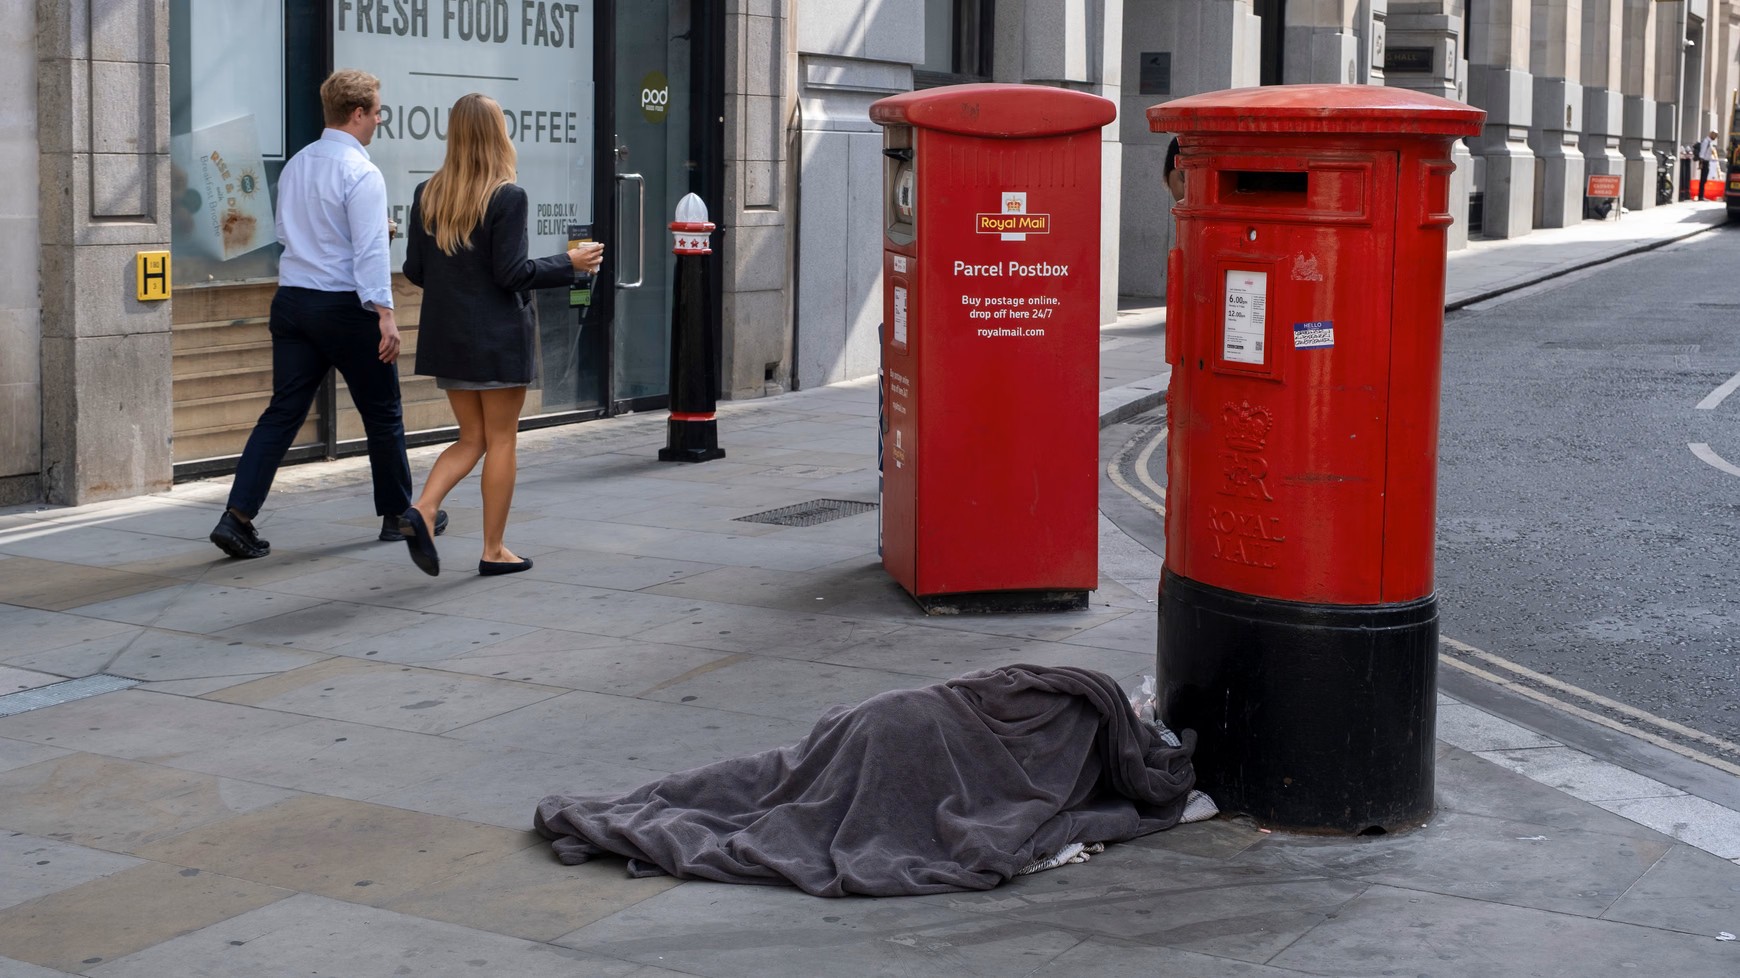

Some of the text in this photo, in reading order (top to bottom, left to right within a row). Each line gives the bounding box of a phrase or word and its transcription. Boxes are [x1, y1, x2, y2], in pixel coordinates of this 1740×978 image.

[338, 0, 579, 49] FRESH FOOD FAST
[641, 86, 668, 108] pod
[377, 104, 577, 143] RIOU OFFEE
[200, 155, 222, 237] Breakfast Brioche
[537, 218, 577, 235] DELIVE
[981, 217, 1045, 231] Royal Mail
[144, 256, 166, 295] H
[953, 261, 1069, 277] Parcel Postbox
[961, 295, 1061, 307] Buy postage online,
[969, 309, 1053, 320] drop off here 24/7
[977, 327, 1045, 339] royalmail.com
[1207, 505, 1286, 543] ROYAL
